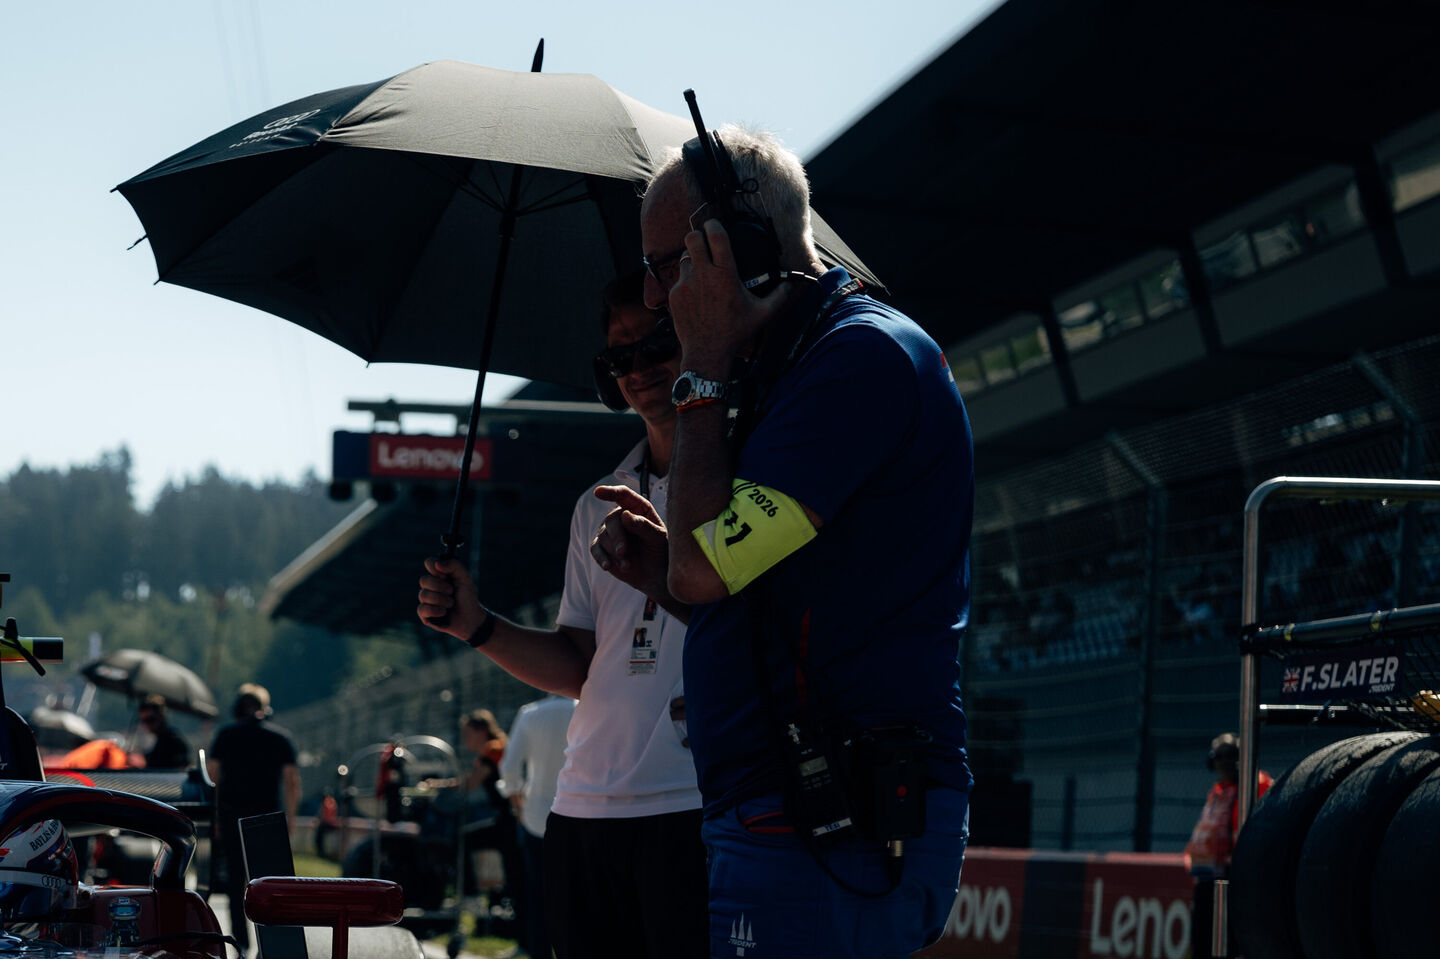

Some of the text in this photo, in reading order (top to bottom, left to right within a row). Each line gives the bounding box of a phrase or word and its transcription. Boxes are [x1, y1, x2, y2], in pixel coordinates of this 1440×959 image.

[748, 488, 779, 518] 2026
[1300, 656, 1400, 692] F.SLATER
[952, 884, 1012, 943] ovo
